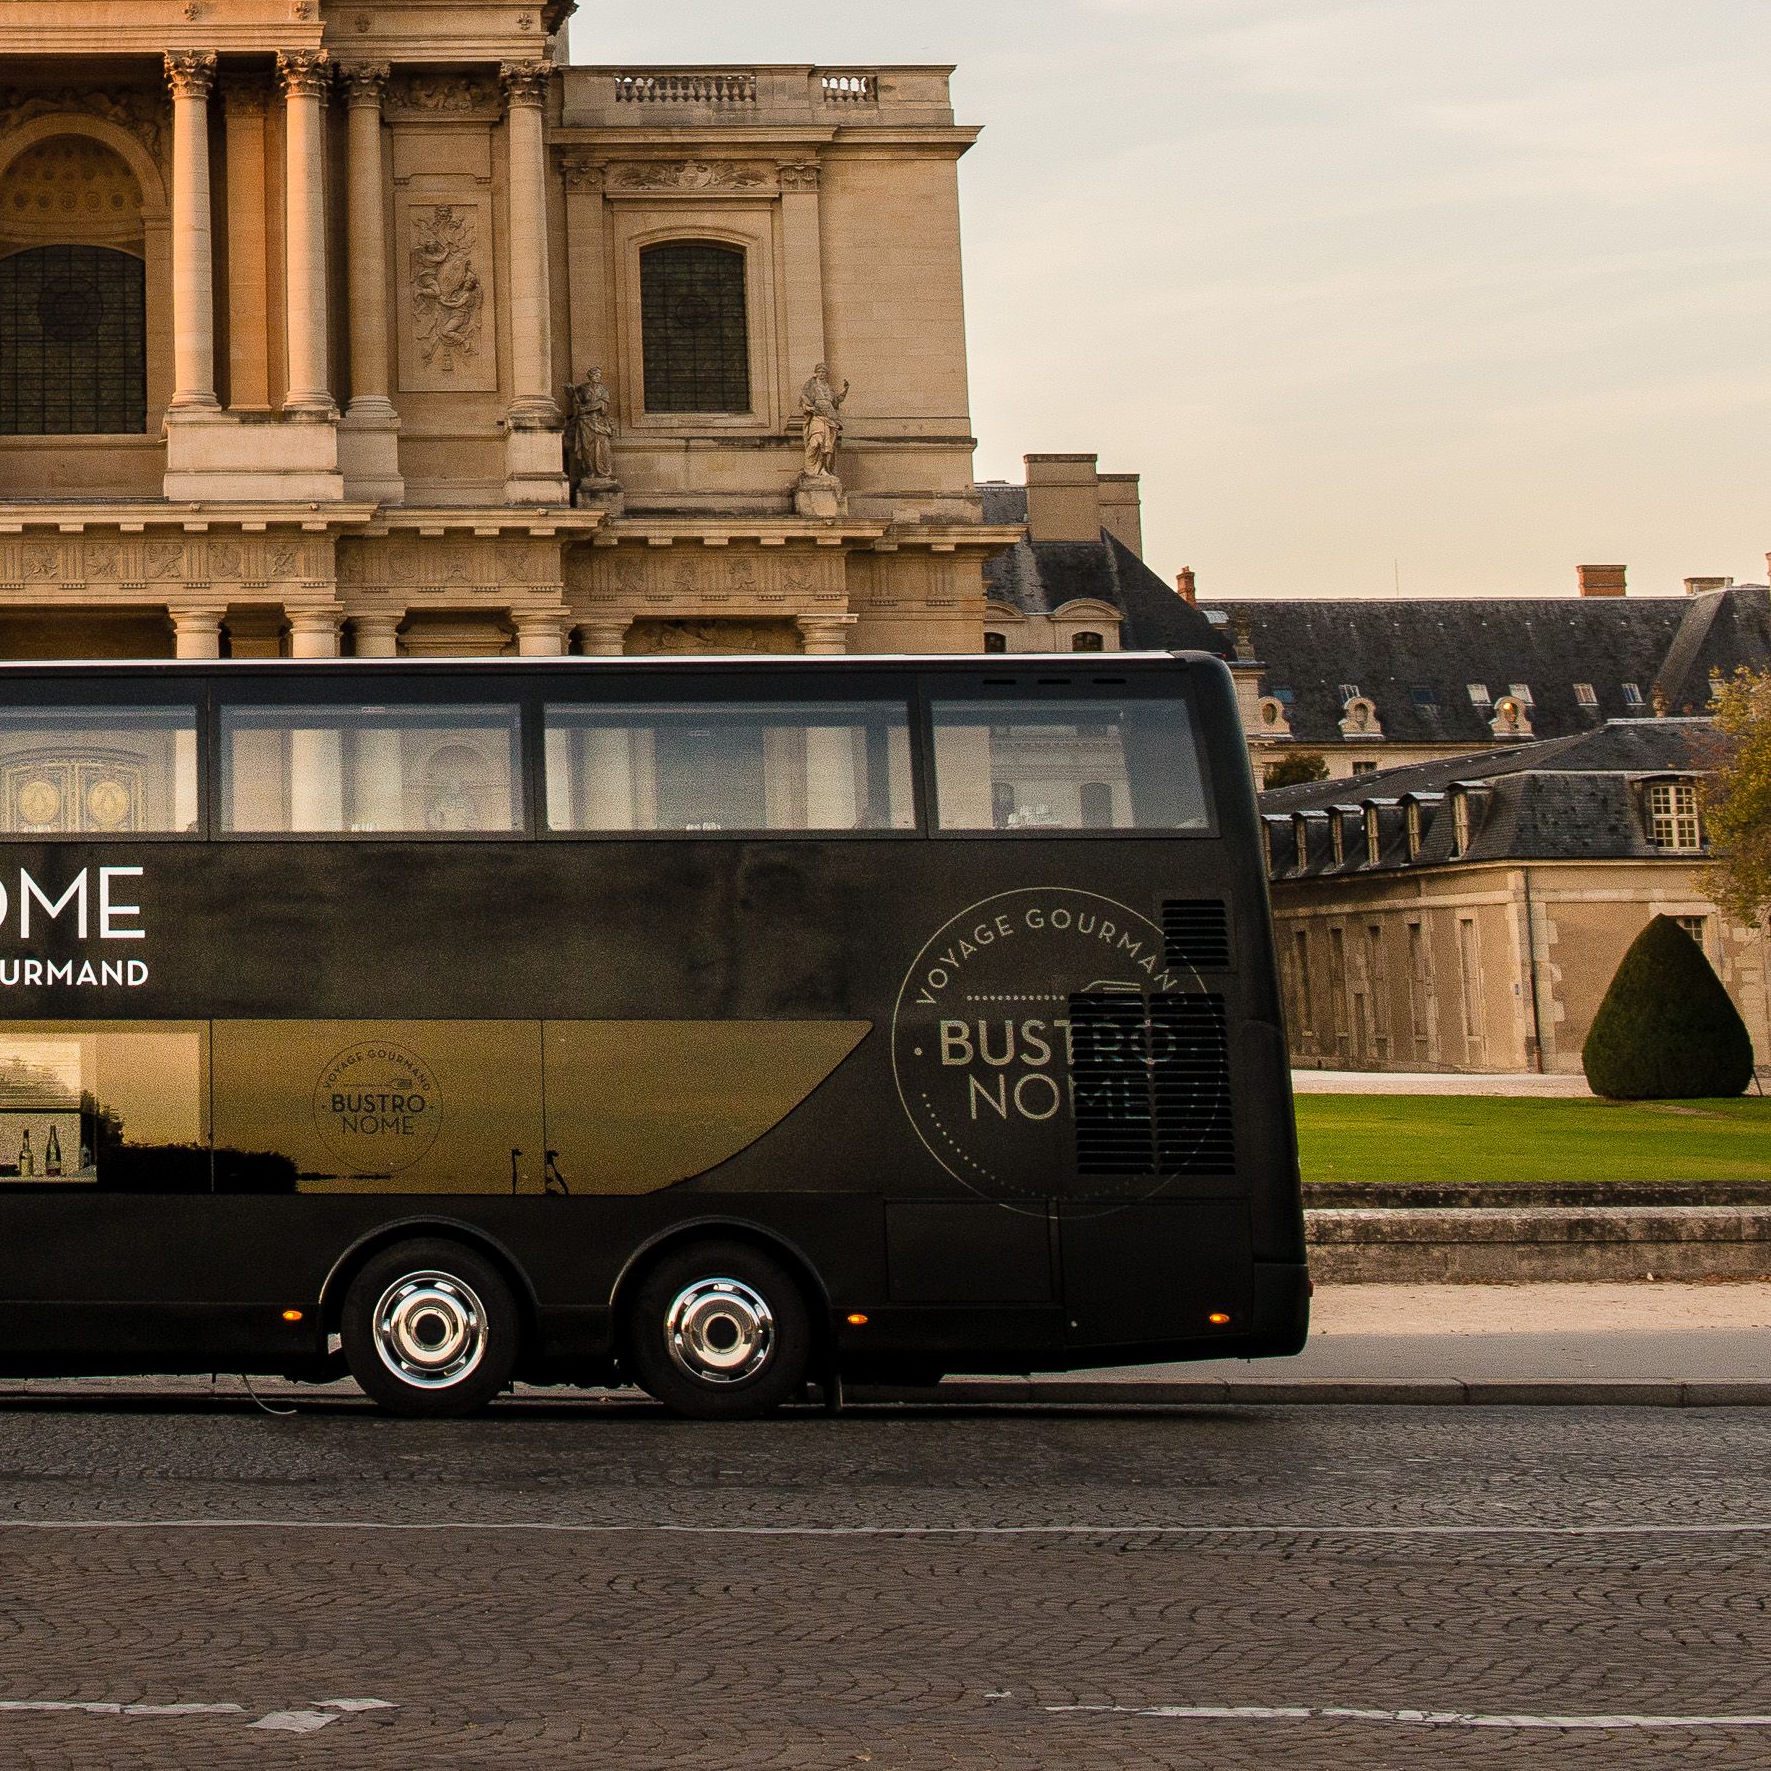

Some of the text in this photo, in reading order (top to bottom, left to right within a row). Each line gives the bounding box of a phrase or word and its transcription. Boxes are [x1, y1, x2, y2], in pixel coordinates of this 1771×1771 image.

[916, 914, 1014, 1005] VOYAGE
[323, 1049, 431, 1091] VOYAGE GOURMAND
[331, 1093, 426, 1113] BUSTRO
[341, 1115, 415, 1135] NOME
